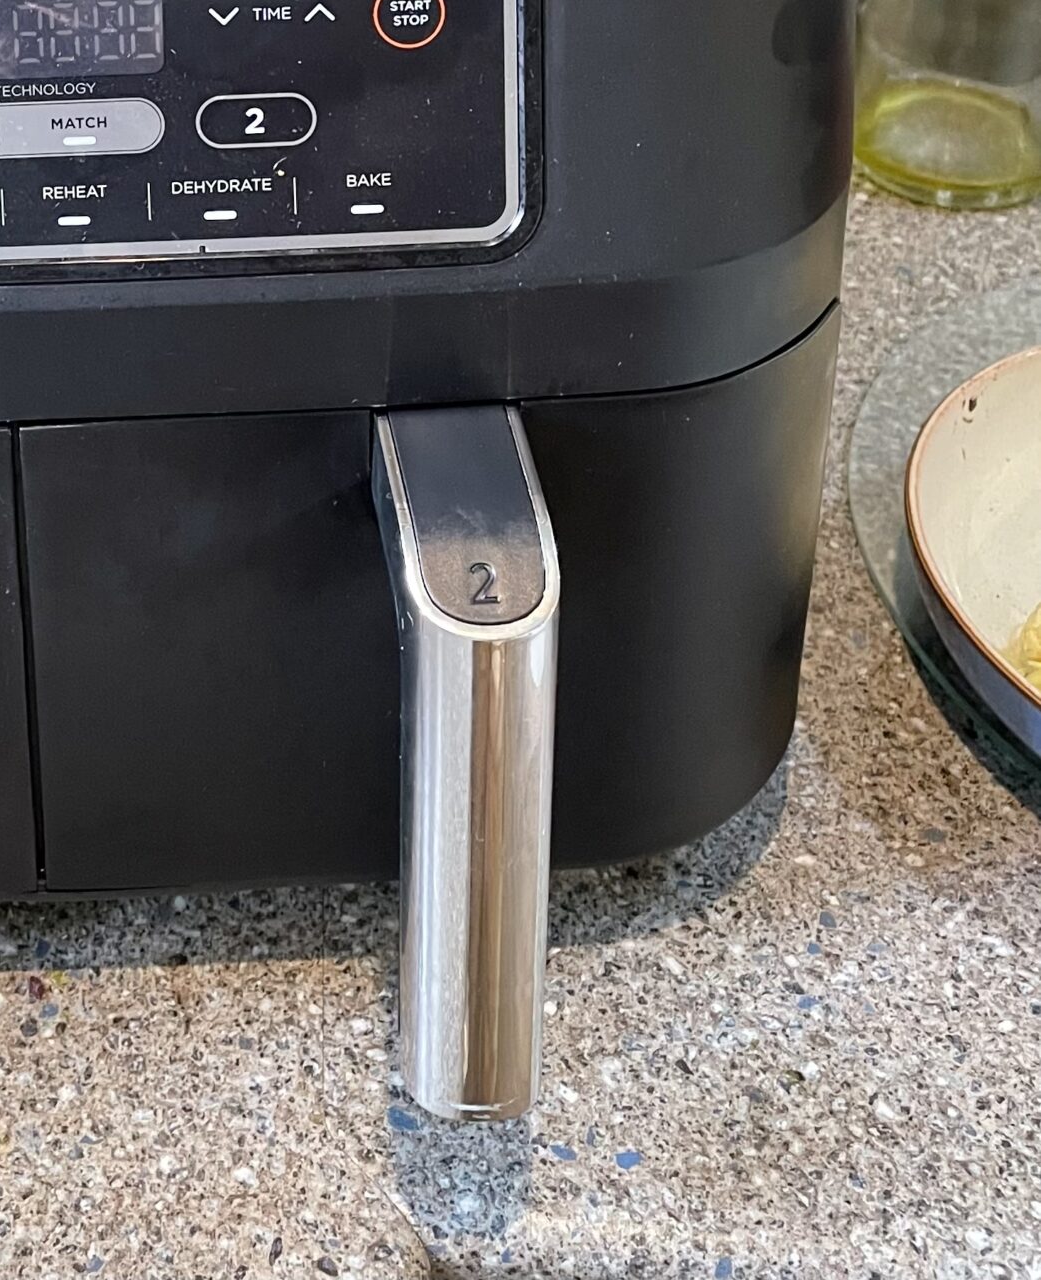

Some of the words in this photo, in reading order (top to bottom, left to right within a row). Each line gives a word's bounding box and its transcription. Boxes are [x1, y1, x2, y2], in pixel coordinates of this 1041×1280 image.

[252, 6, 291, 22] TIME
[393, 13, 429, 27] STOP
[51, 116, 108, 131] MATCH
[244, 108, 265, 135] 2
[171, 178, 273, 196] DEHYDRATE
[346, 173, 392, 187] BAKE
[42, 185, 107, 200] REHEAT
[470, 562, 500, 605] 2
